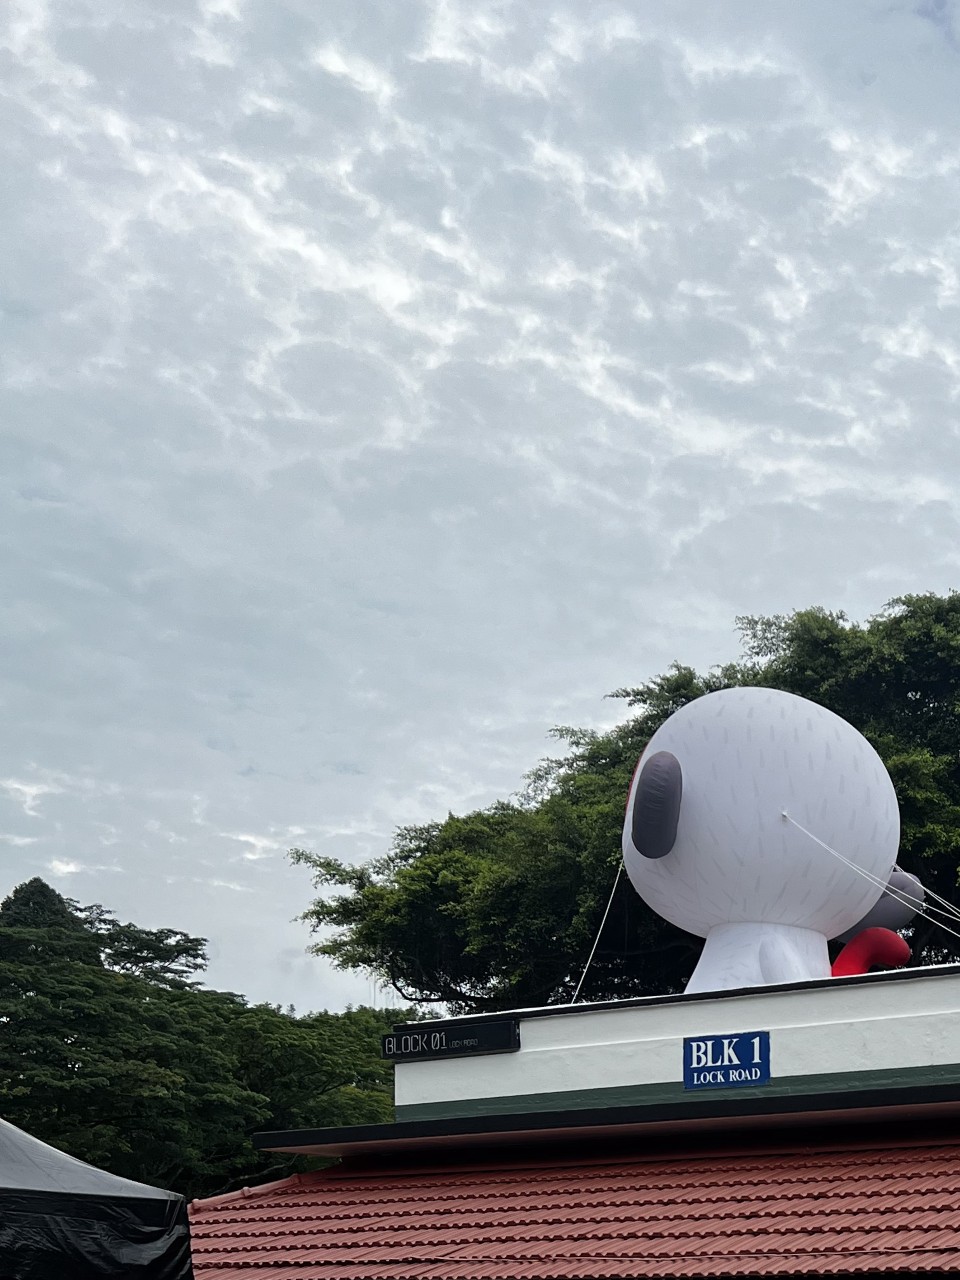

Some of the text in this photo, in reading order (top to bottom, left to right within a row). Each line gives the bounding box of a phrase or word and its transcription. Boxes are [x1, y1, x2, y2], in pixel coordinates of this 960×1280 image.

[385, 1034, 428, 1054] BLOCK
[431, 1032, 448, 1050] 01
[690, 1036, 762, 1068] BLK 1
[693, 1067, 761, 1085] LOCK ROAD
